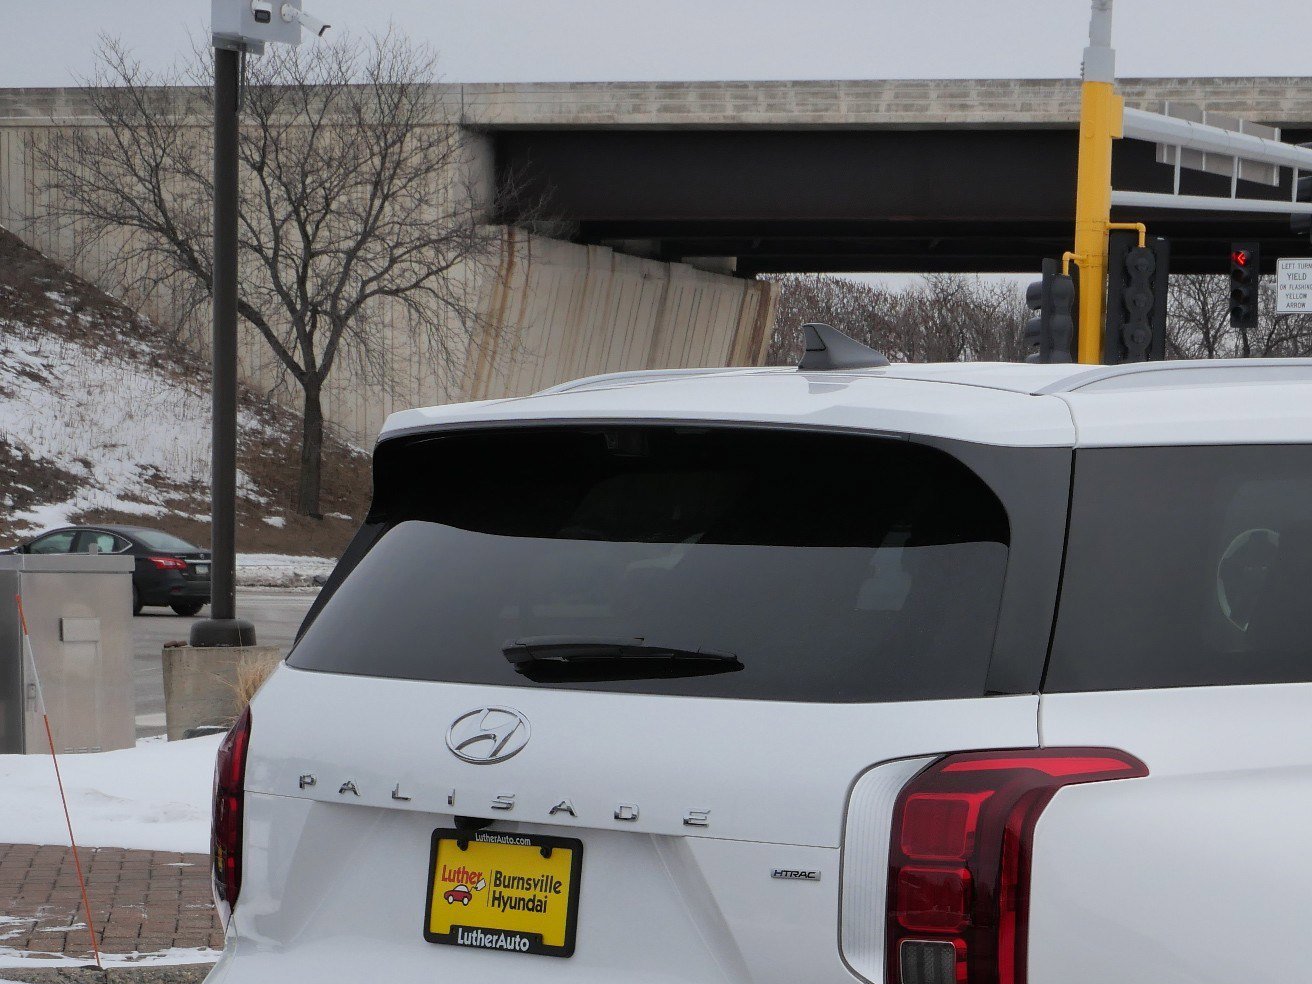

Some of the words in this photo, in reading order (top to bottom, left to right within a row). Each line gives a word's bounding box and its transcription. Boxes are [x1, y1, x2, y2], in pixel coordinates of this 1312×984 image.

[1287, 272, 1307, 281] YIELD
[299, 773, 712, 829] PALISADE
[475, 832, 532, 847] LutherAuto.com
[441, 864, 483, 886] Luther
[493, 870, 563, 895] Burnsville
[773, 869, 817, 879] HTRAC
[490, 890, 549, 914] Hyundai
[457, 927, 530, 952] LutherAuto
